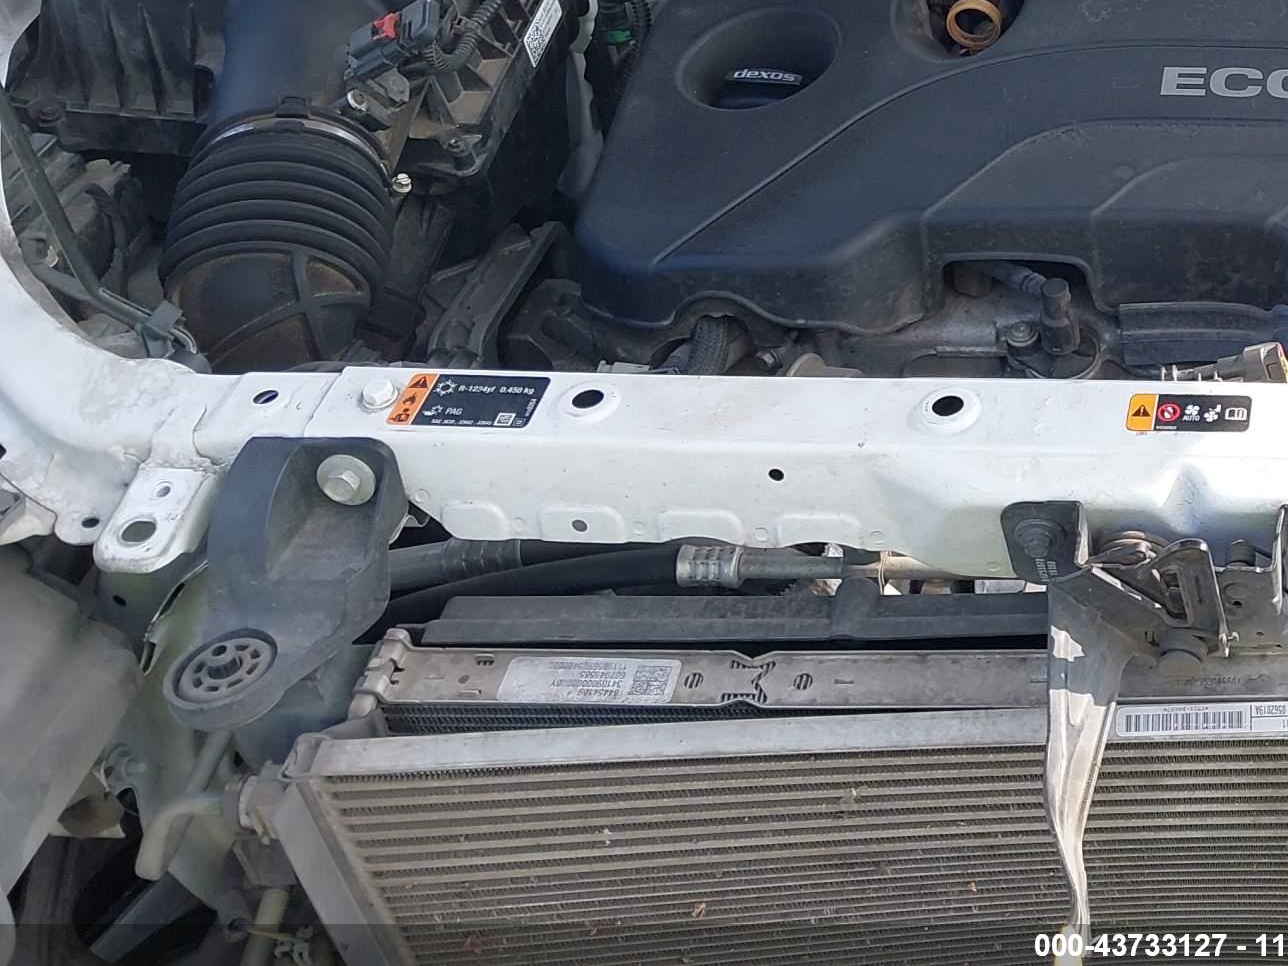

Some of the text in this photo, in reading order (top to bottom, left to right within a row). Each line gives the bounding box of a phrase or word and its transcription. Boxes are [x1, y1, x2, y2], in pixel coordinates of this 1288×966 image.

[734, 69, 795, 81] dexos
[458, 385, 535, 395] R-1234yf 0.450 kg
[1182, 414, 1200, 422] AUTO
